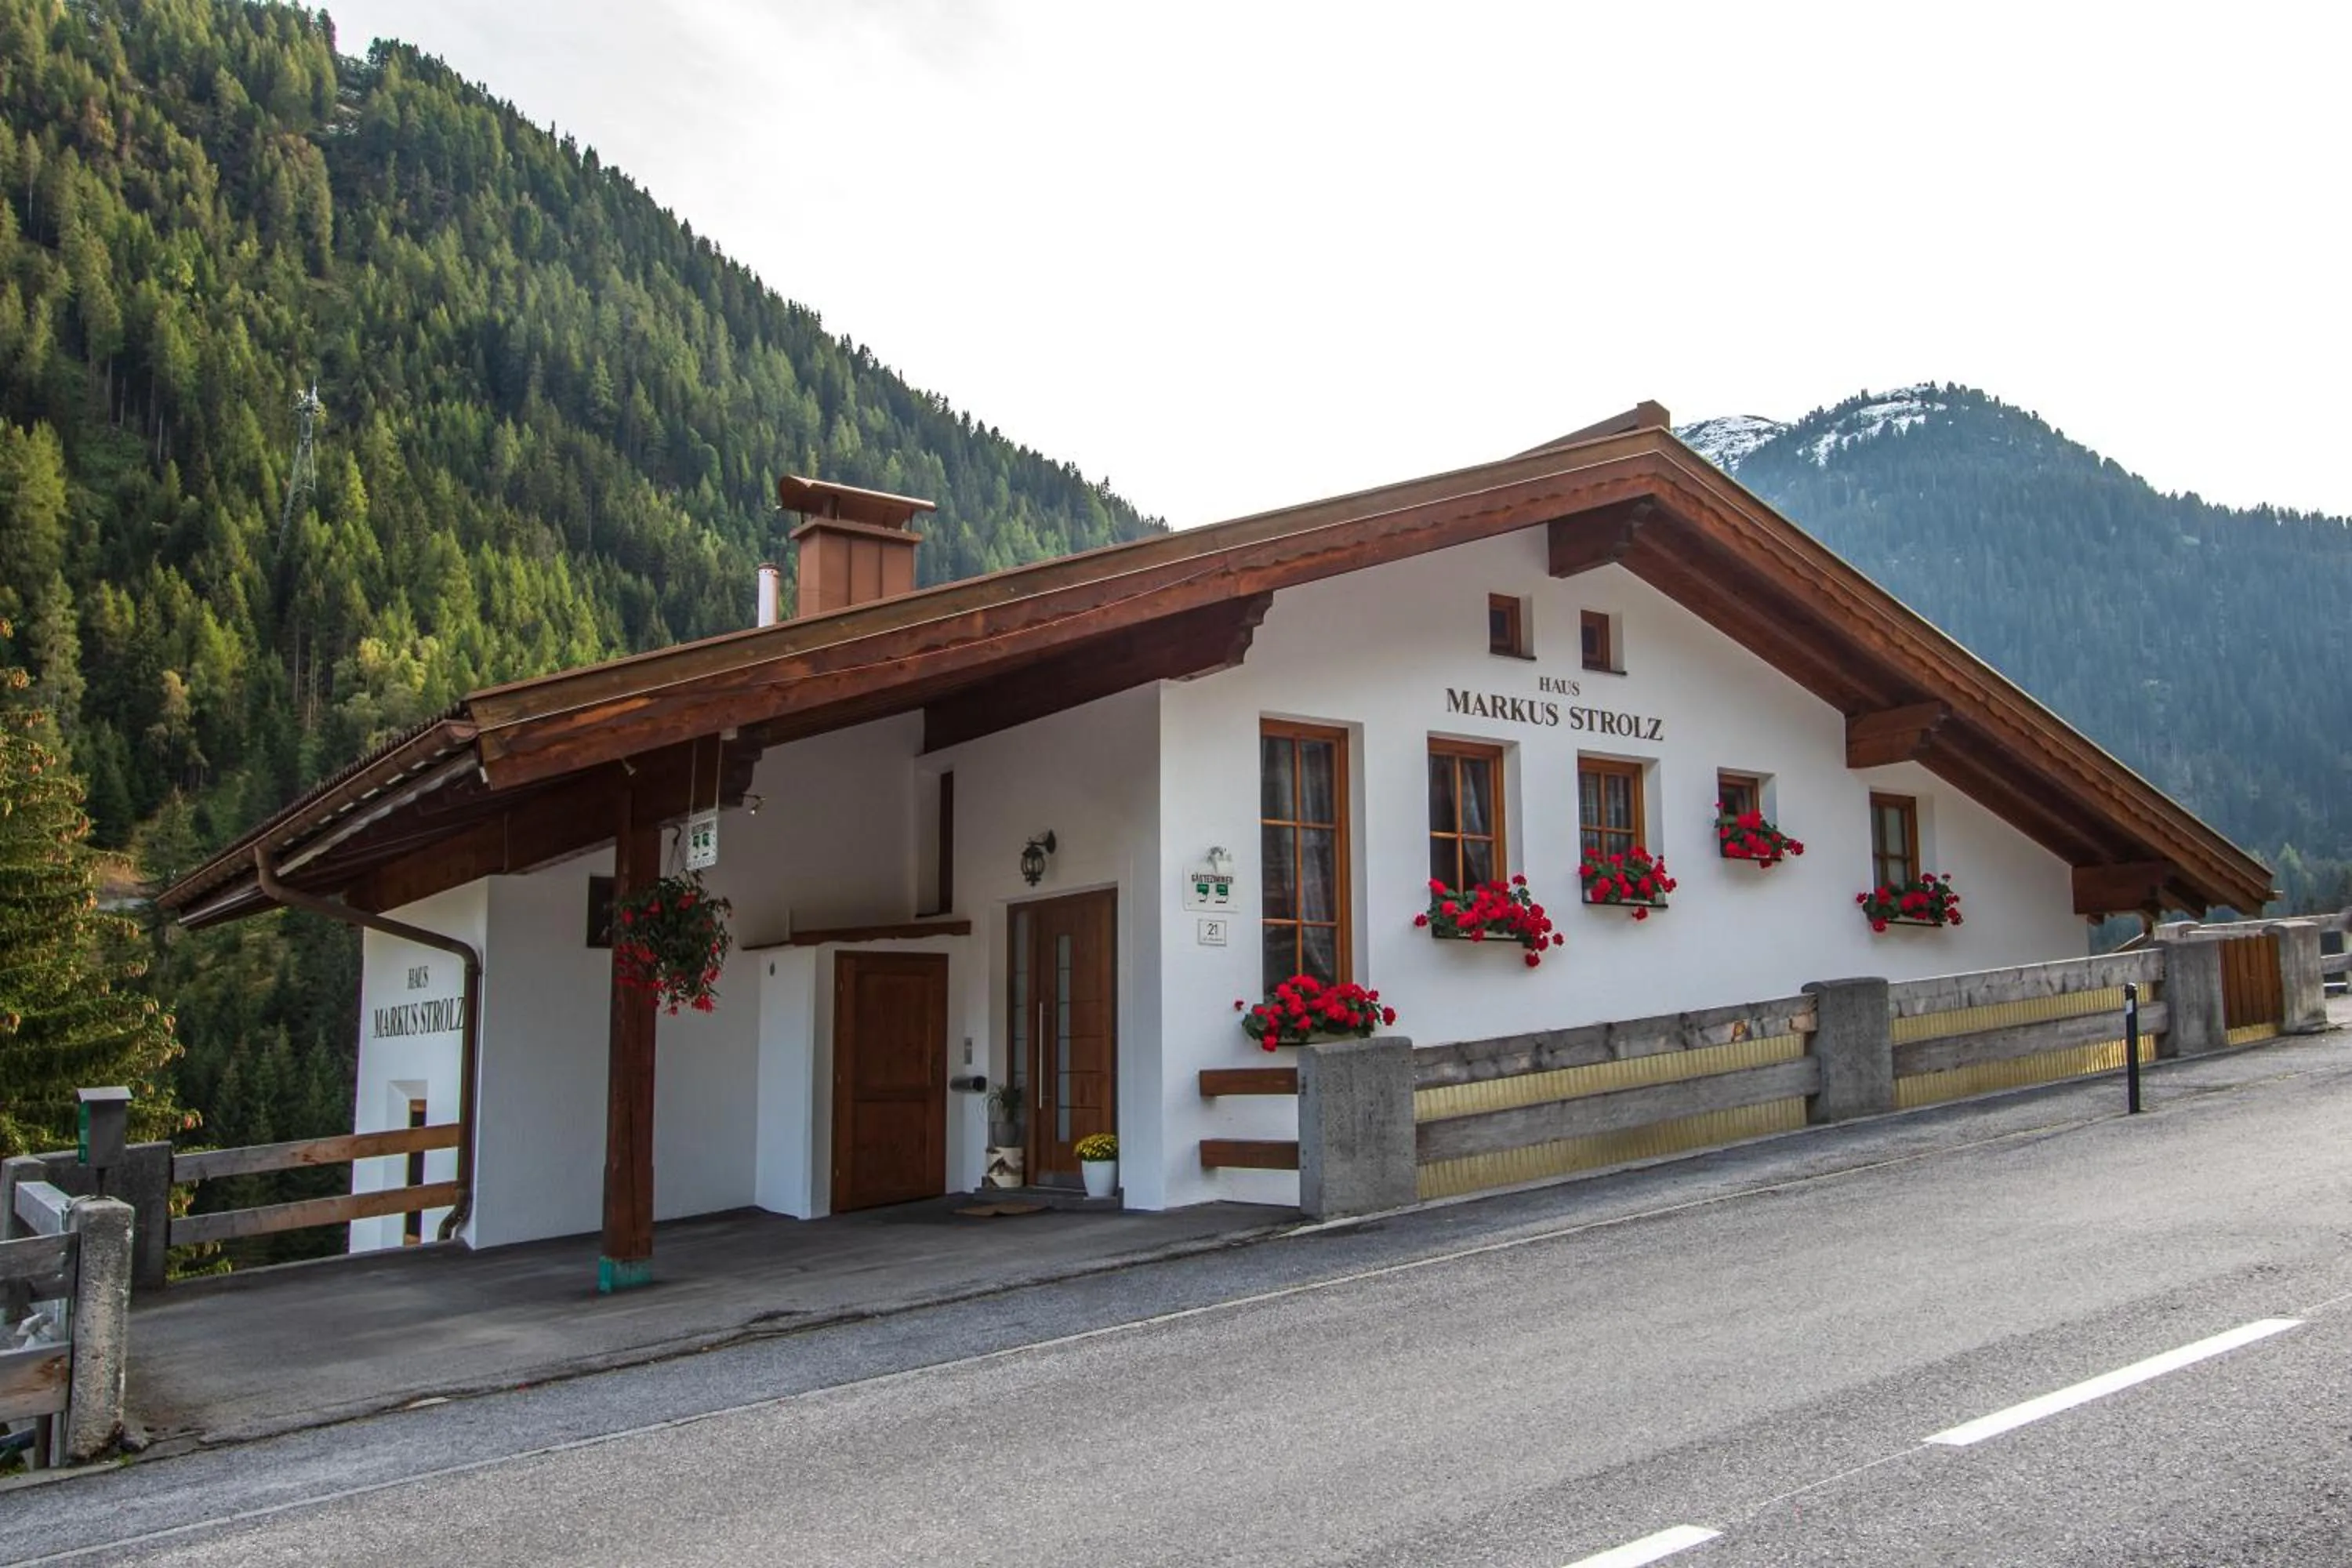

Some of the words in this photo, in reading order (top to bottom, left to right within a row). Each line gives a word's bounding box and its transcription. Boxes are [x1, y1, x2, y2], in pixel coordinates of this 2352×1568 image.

[1539, 677, 1581, 696] HAUS
[1446, 688, 1559, 727] MARKUS
[1570, 706, 1664, 741] STROLZ
[1207, 923, 1218, 935] 21
[408, 965, 429, 989] HAUS
[374, 1003, 418, 1038] MARKUS
[419, 996, 465, 1035] STROLZ
